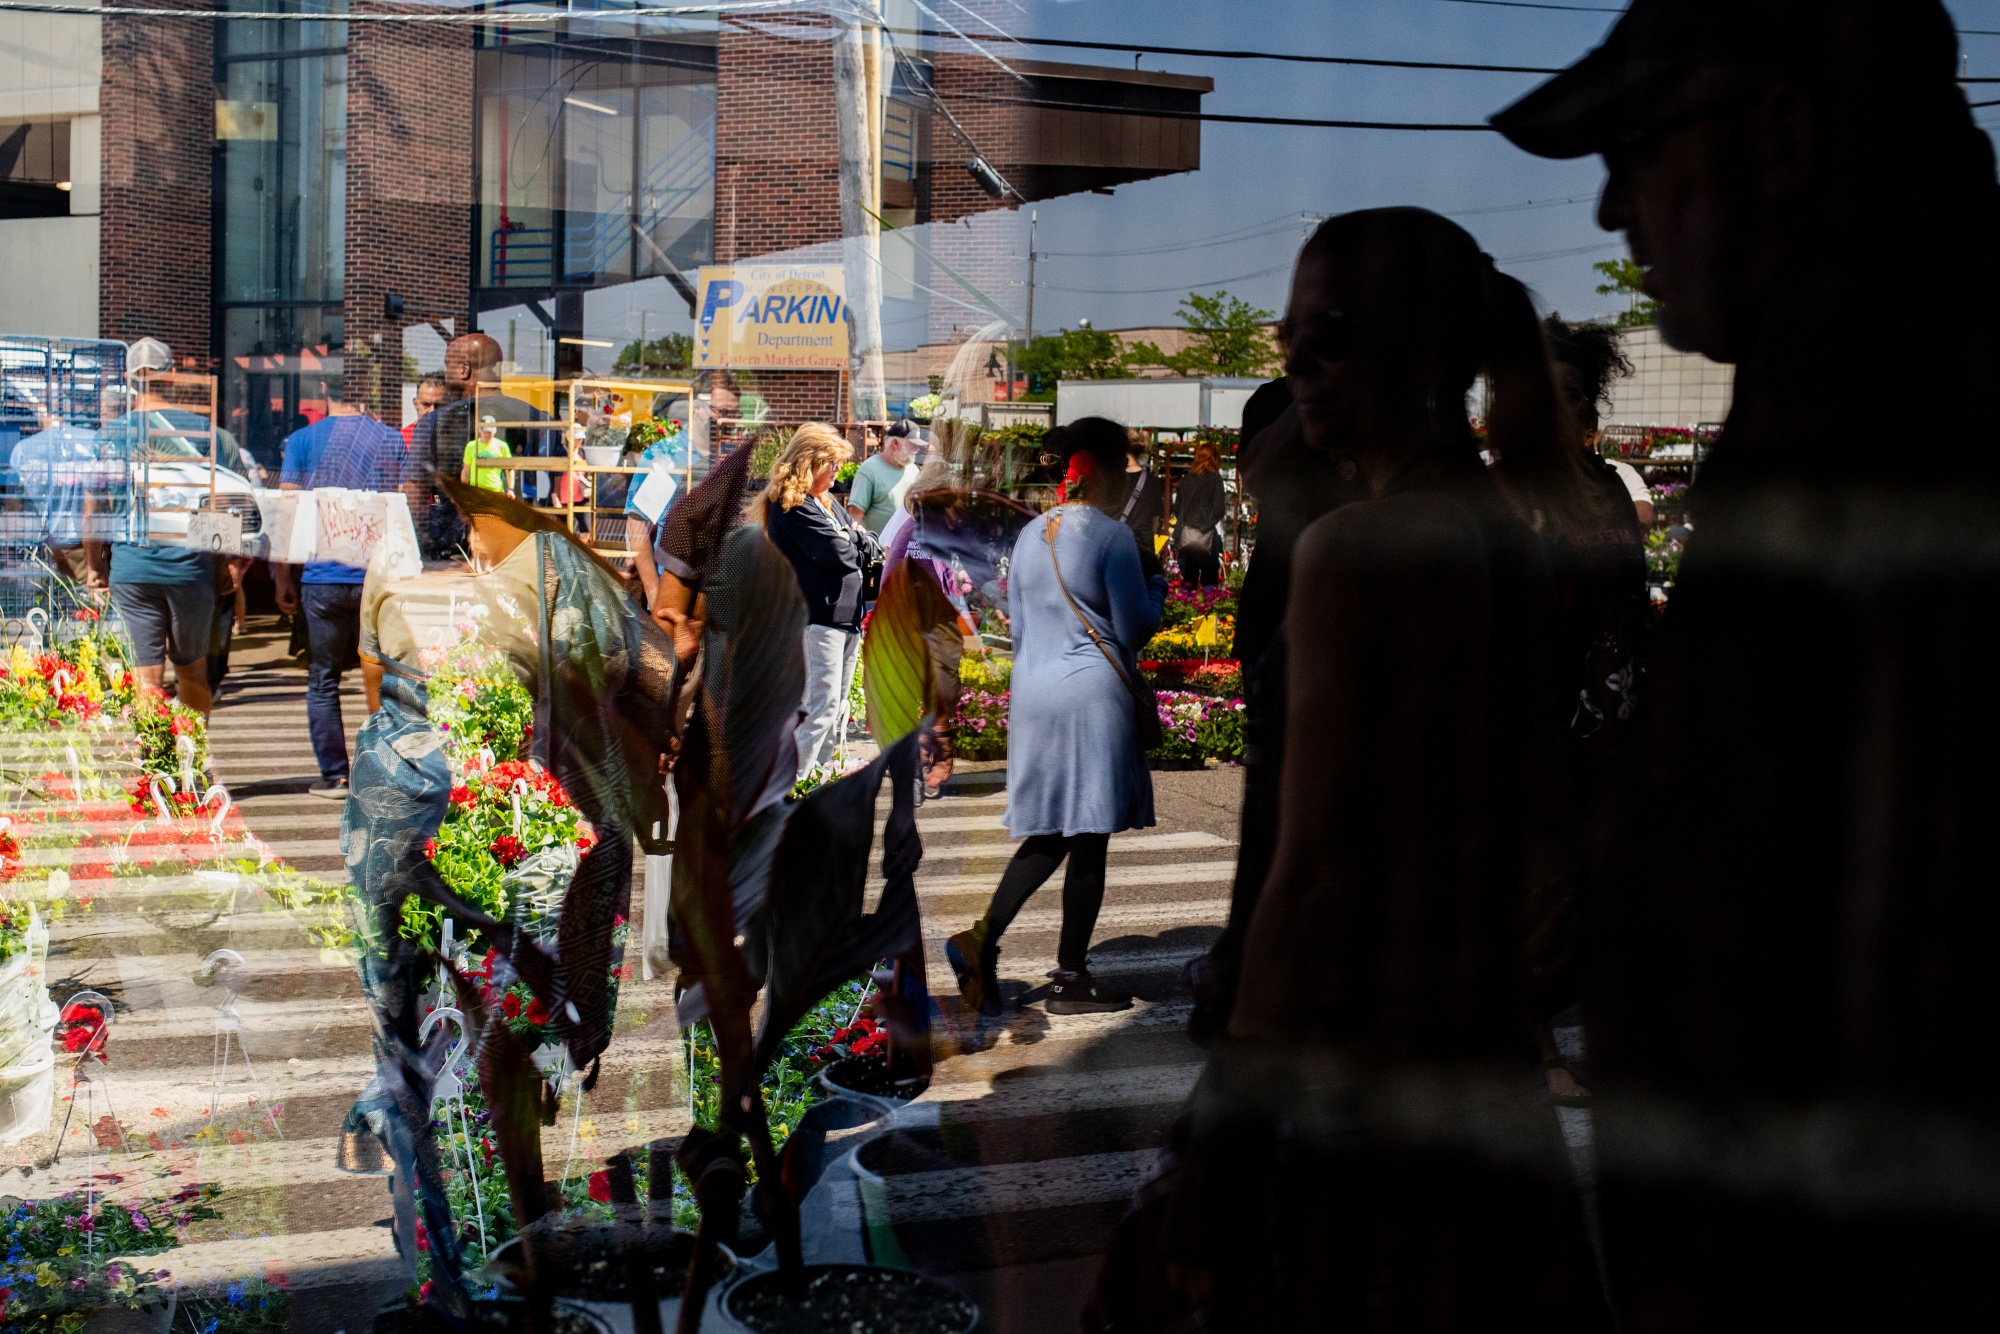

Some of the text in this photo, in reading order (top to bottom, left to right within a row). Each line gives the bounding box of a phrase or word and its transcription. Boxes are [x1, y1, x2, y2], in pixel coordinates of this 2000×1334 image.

[751, 268, 825, 282] City of Detroit
[745, 283, 832, 294] MUNICIPAL
[757, 332, 833, 349] Department
[719, 353, 848, 368] Eastern Market Garage
